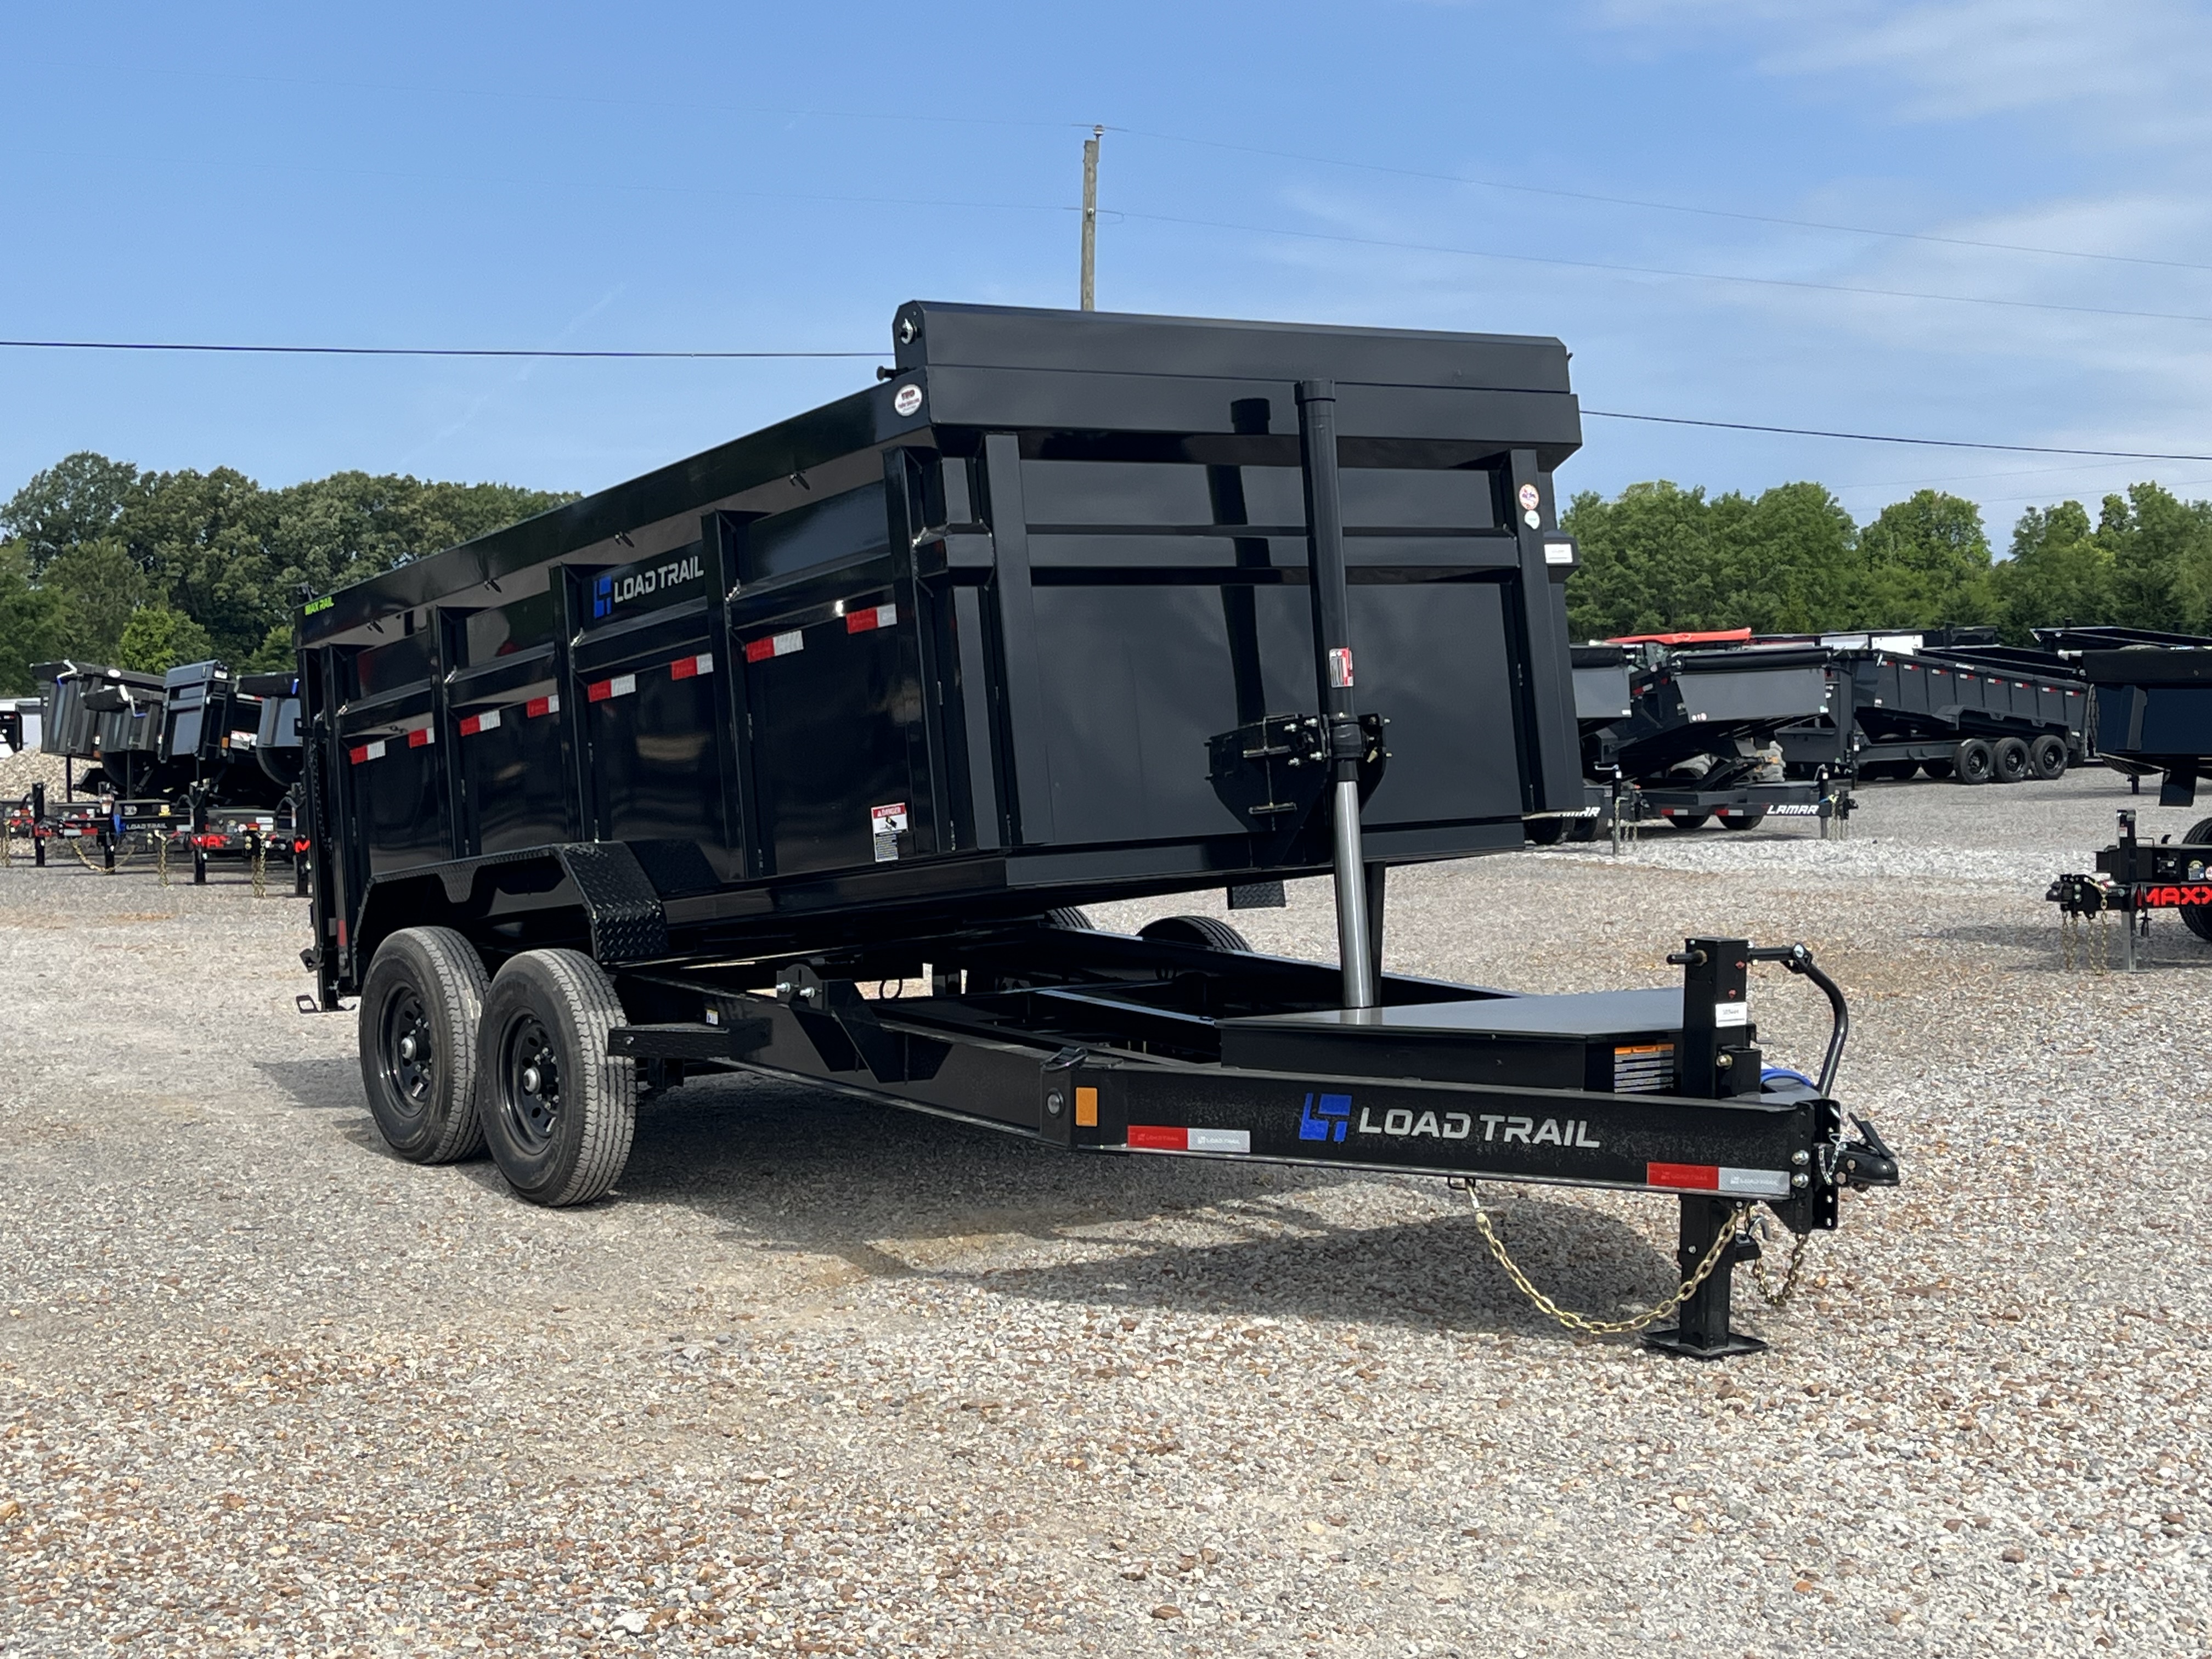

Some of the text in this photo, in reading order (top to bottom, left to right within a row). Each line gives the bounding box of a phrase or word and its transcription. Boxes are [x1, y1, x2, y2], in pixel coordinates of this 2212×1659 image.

[614, 556, 704, 603] LOAD TRAIL
[1767, 805, 1819, 815] LAMAR
[1359, 1107, 1600, 1148] LOAD TRAIL
